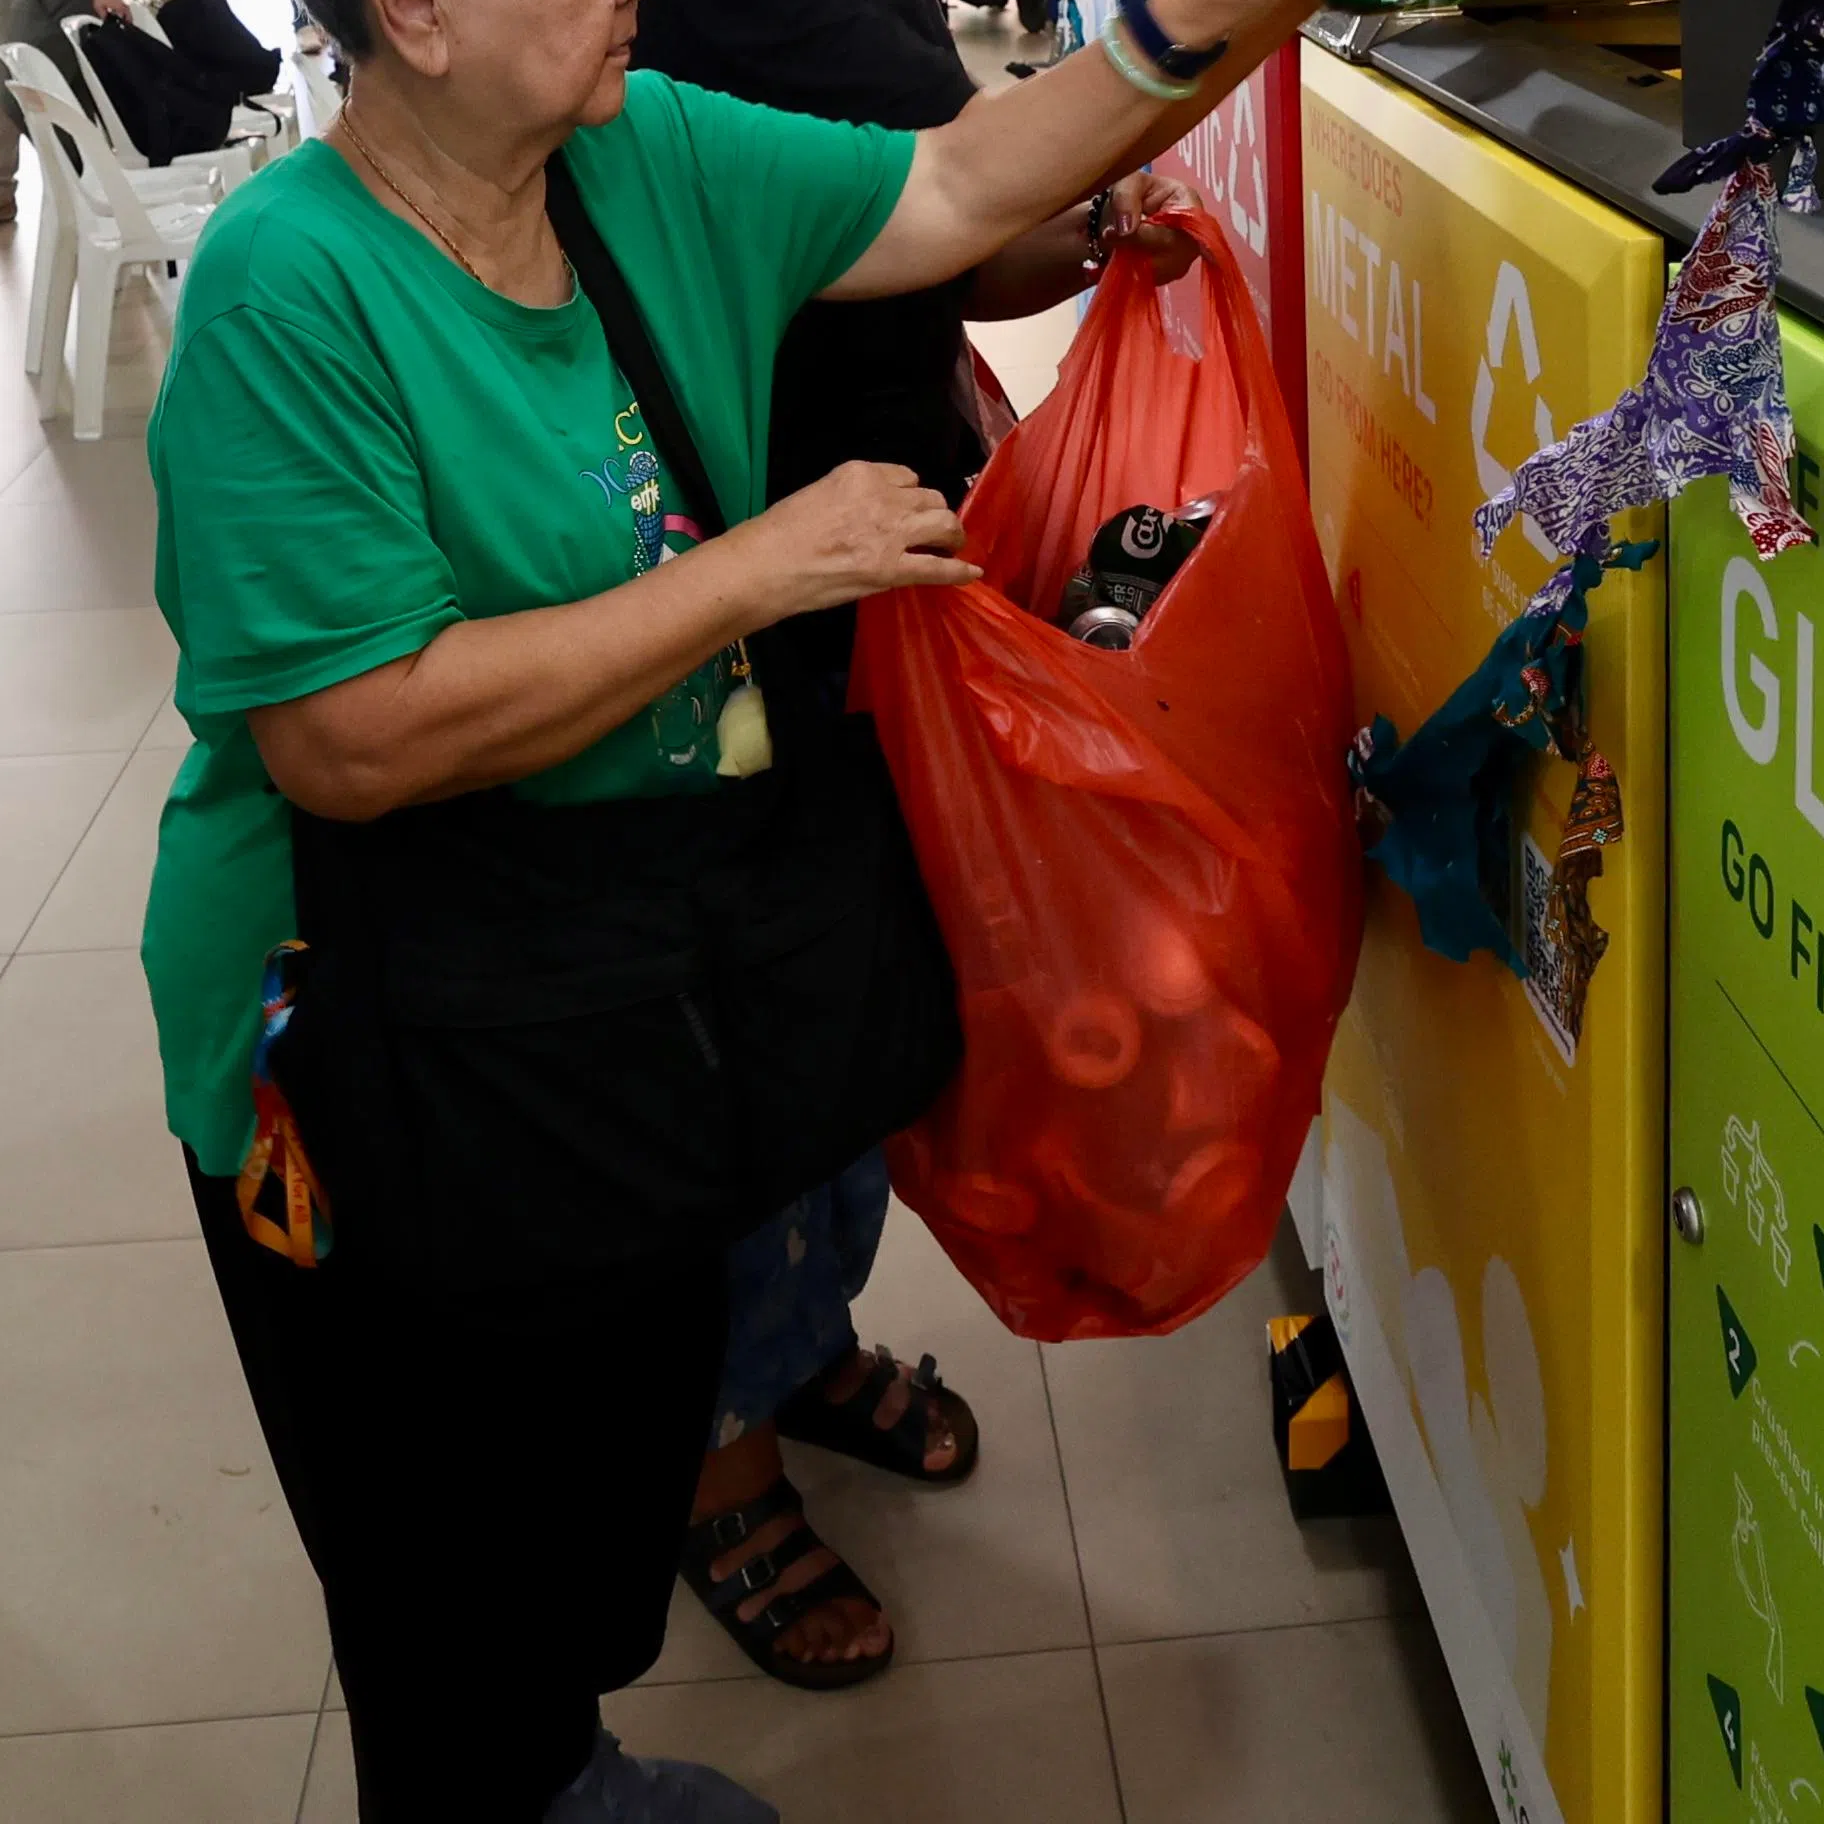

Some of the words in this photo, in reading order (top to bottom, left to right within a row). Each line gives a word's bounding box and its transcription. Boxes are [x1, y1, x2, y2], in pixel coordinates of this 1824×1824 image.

[1360, 142, 1403, 217] DOES
[1311, 190, 1437, 425] METAL
[1336, 379, 1377, 461] FROM
[1380, 425, 1434, 531] HERE?
[1720, 818, 1775, 941] GO
[1728, 1328, 1741, 1375] 2
[1752, 1376, 1811, 1496] Crushed
[1752, 1419, 1797, 1512] pieces
[1724, 1709, 1736, 1752] 4
